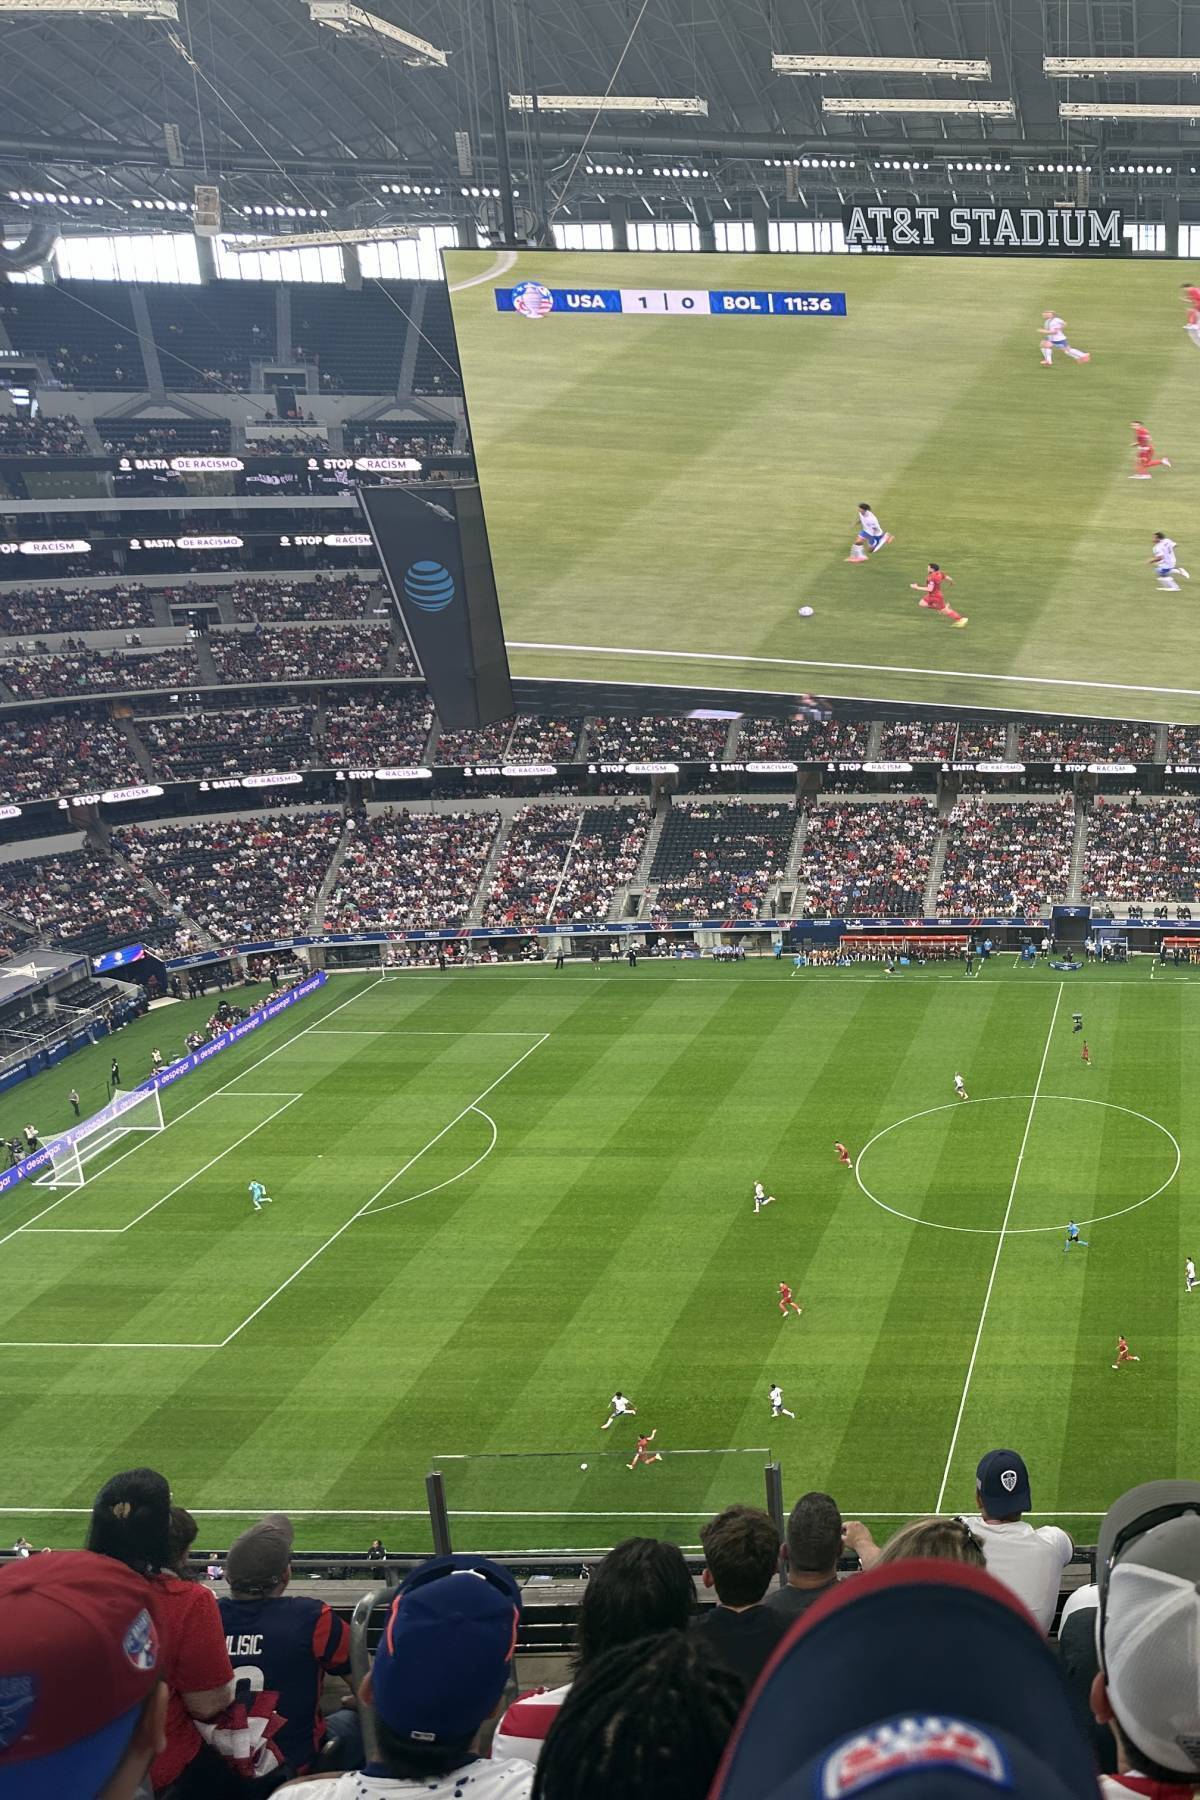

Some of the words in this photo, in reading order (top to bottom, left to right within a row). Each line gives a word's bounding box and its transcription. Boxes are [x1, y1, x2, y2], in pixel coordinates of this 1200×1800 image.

[846, 207, 938, 244] AT&T
[950, 208, 1121, 247] STADIUM
[566, 294, 606, 308] USA
[638, 297, 647, 308] 1
[682, 298, 695, 308] 0
[723, 296, 761, 310] BOL
[784, 298, 832, 311] 11:36
[135, 458, 169, 470] BASTA
[177, 460, 190, 468] DE
[193, 460, 238, 469] RACISMO
[323, 458, 353, 470] STOP
[367, 460, 406, 468] RACISM
[144, 539, 176, 548] BASTA
[294, 536, 322, 545] STOP
[348, 770, 374, 779] STOP
[600, 765, 624, 773] STOP
[212, 780, 241, 789] BASTA
[72, 795, 101, 806] STOP
[113, 789, 149, 799] RACISM
[236, 1017, 260, 1036] despegar
[200, 1038, 226, 1060] despegar
[161, 1062, 189, 1084] despegar
[26, 1144, 61, 1171] despegar
[226, 1634, 263, 1655] LISIC
